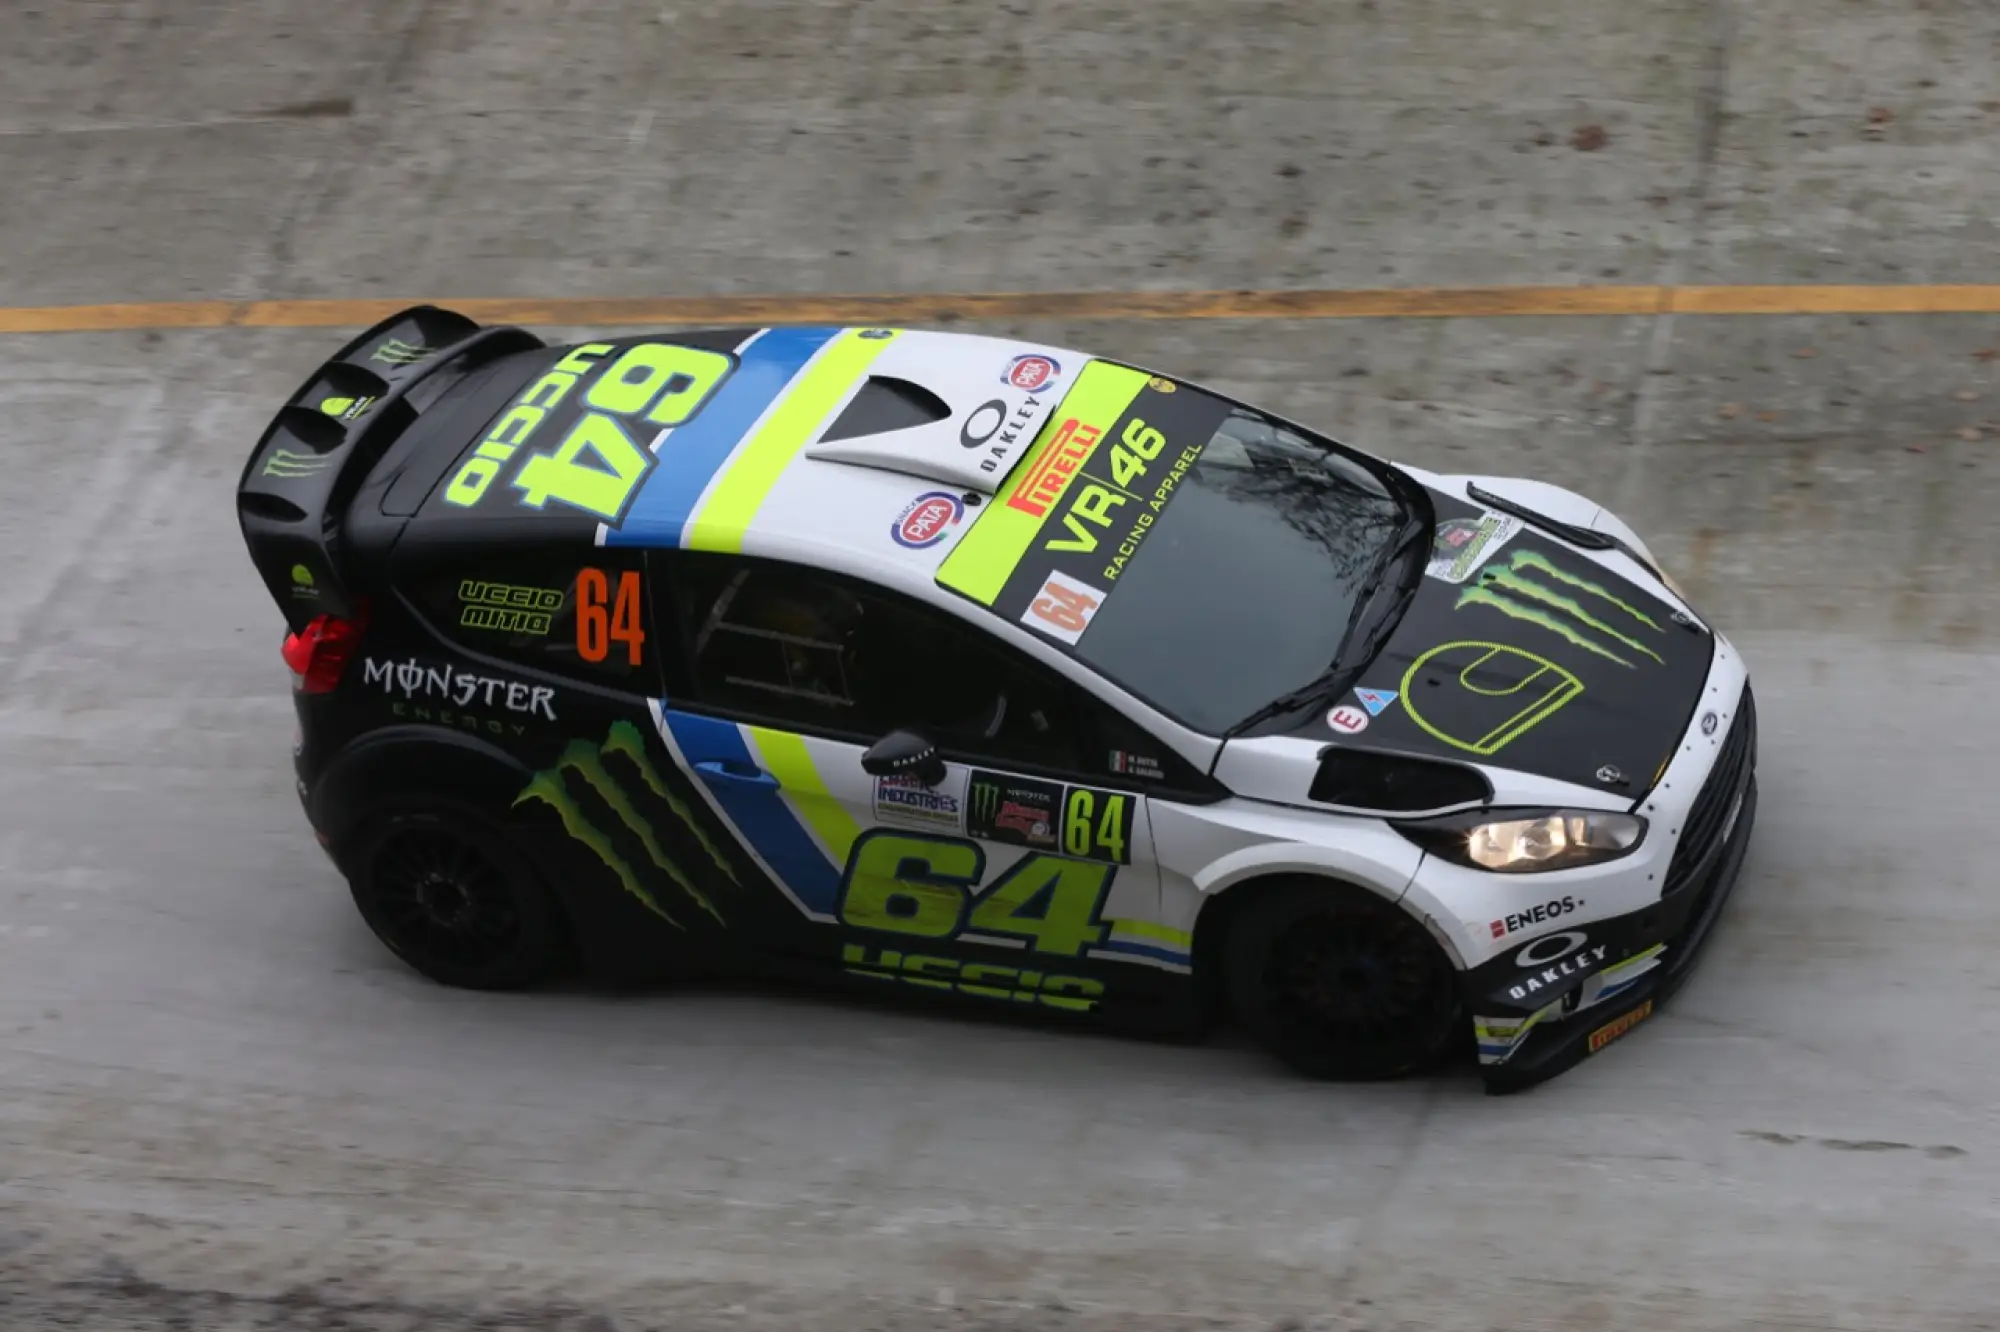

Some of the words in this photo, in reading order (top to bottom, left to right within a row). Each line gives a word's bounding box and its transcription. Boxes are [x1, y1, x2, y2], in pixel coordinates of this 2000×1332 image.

[444, 343, 616, 507] UCCIO
[512, 343, 735, 522] 64
[980, 396, 1040, 473] OAKLEY
[1007, 418, 1101, 518] PIRELLI
[905, 505, 949, 538] PATA
[1103, 514, 1153, 580] RACING
[1149, 444, 1202, 514] APPAREL
[457, 580, 564, 609] UCCIO
[574, 567, 646, 666] 64
[1030, 580, 1099, 633] 64
[364, 656, 558, 721] MONSTER
[1066, 789, 1125, 862] 64
[838, 831, 1116, 957] 64
[1504, 896, 1575, 933] ENEOS
[1508, 945, 1608, 1000] OAKLEY
